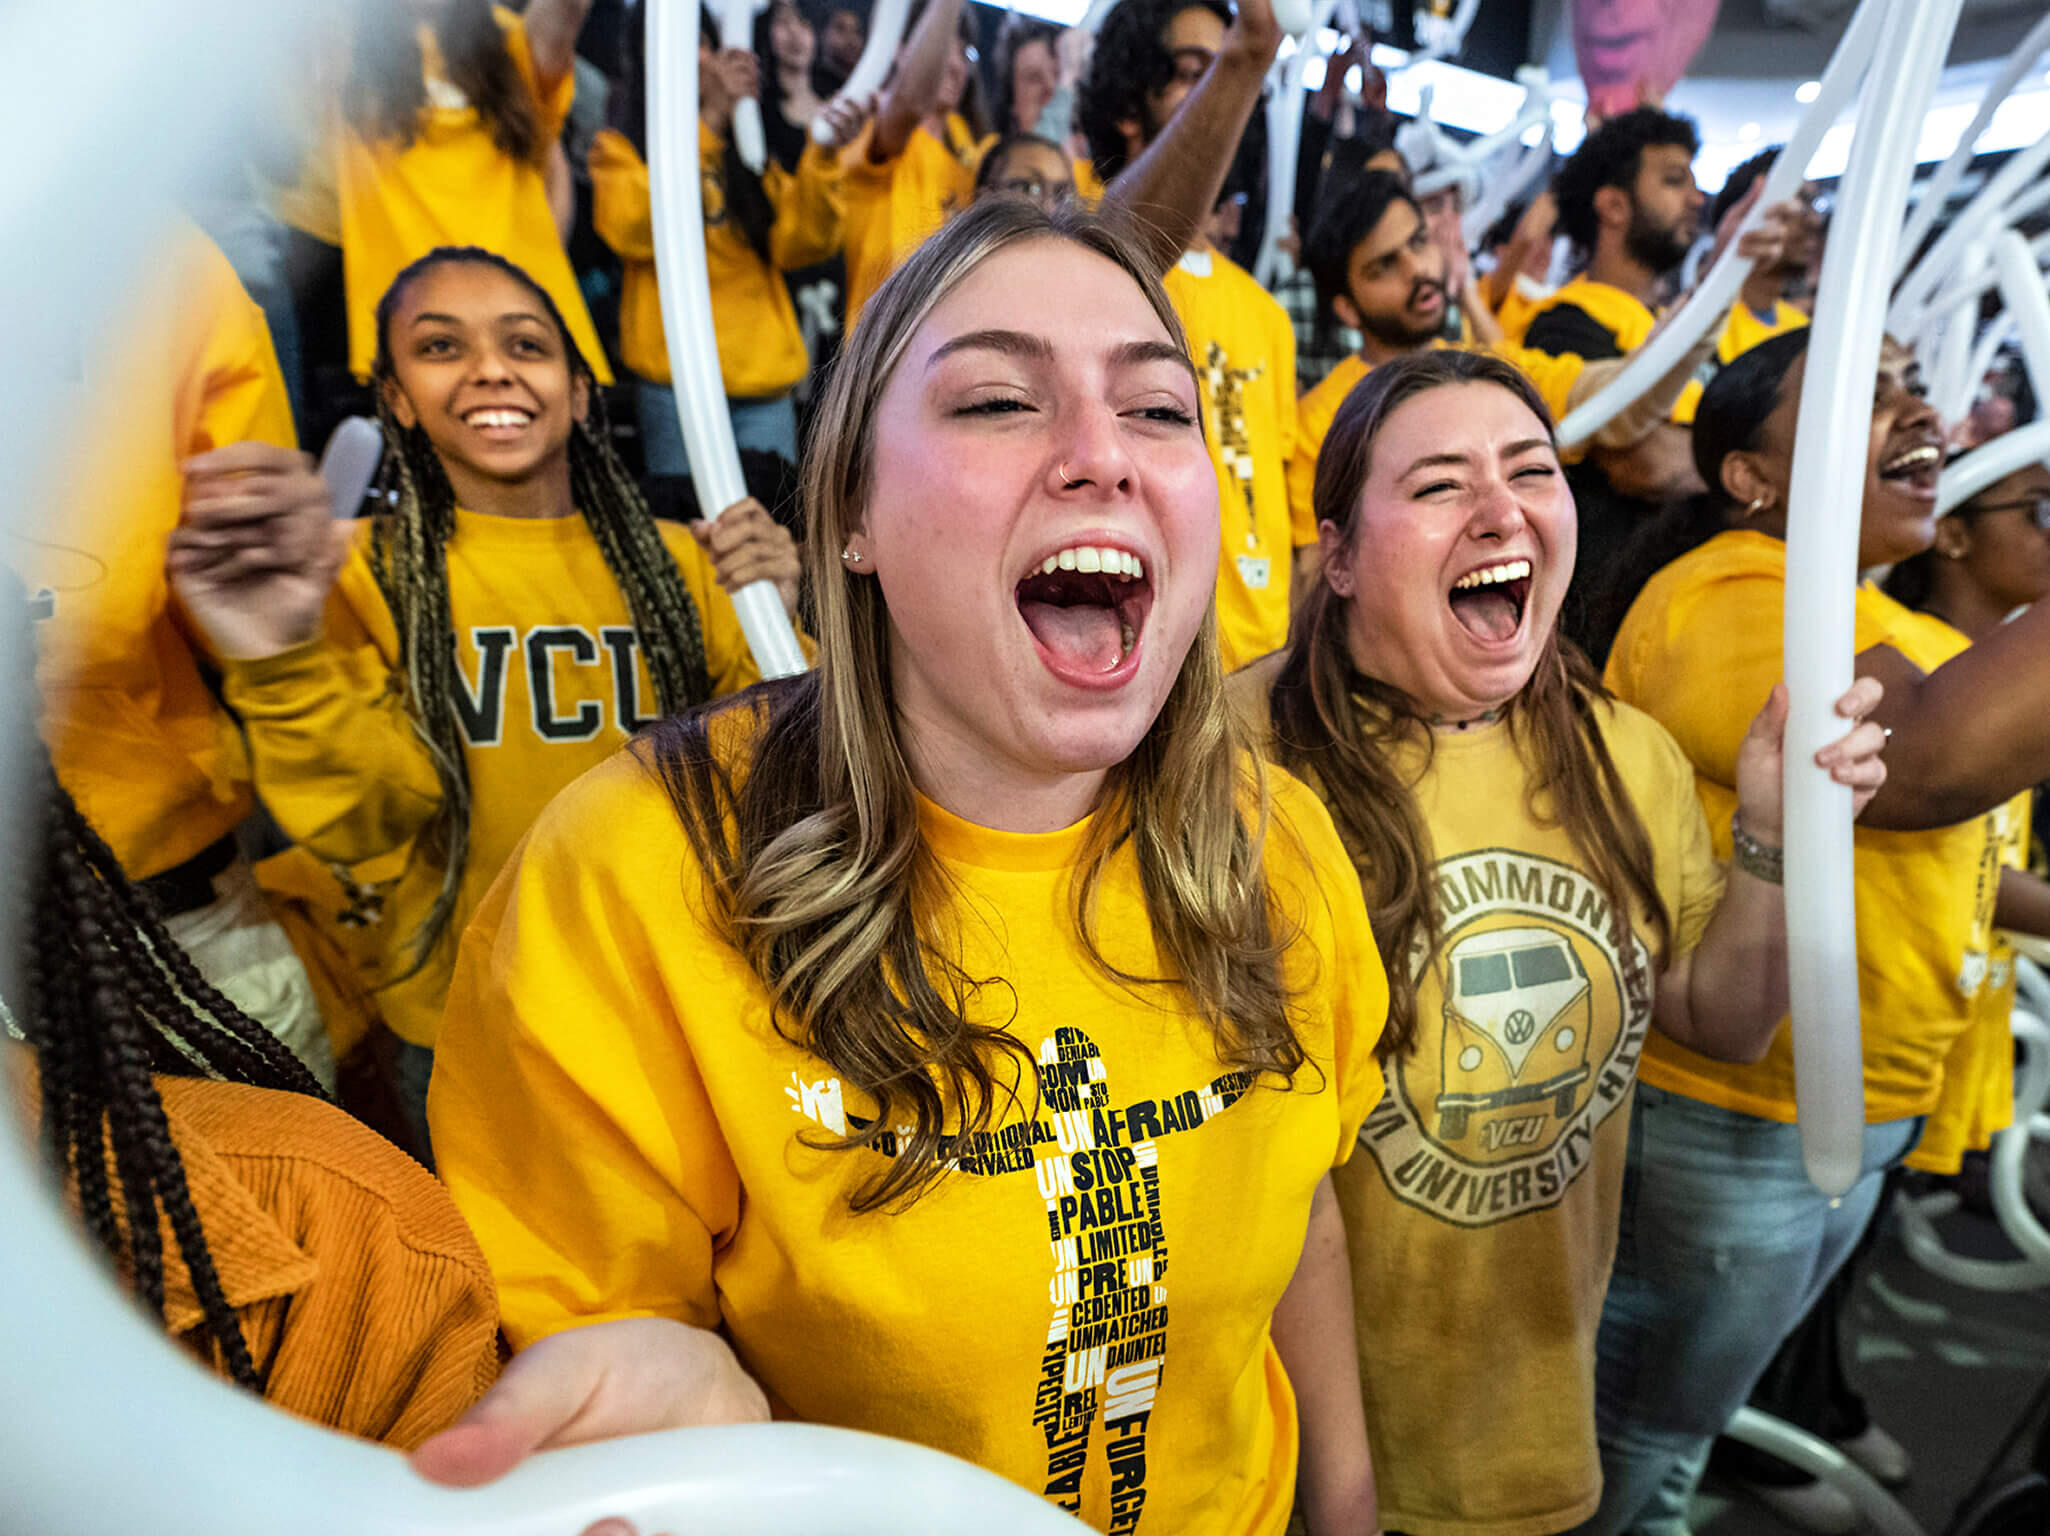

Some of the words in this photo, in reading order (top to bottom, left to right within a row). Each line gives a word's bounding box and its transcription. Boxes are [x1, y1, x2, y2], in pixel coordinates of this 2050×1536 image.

[1432, 861, 1650, 1100] OMMONEALTH
[1482, 1112, 1548, 1152] VCU
[1394, 1114, 1593, 1216] UNIVERSITY
[1060, 1181, 1145, 1235] PABLE
[1069, 1304, 1169, 1354] UNMATCHED
[1071, 1285, 1151, 1328] CEDENTED
